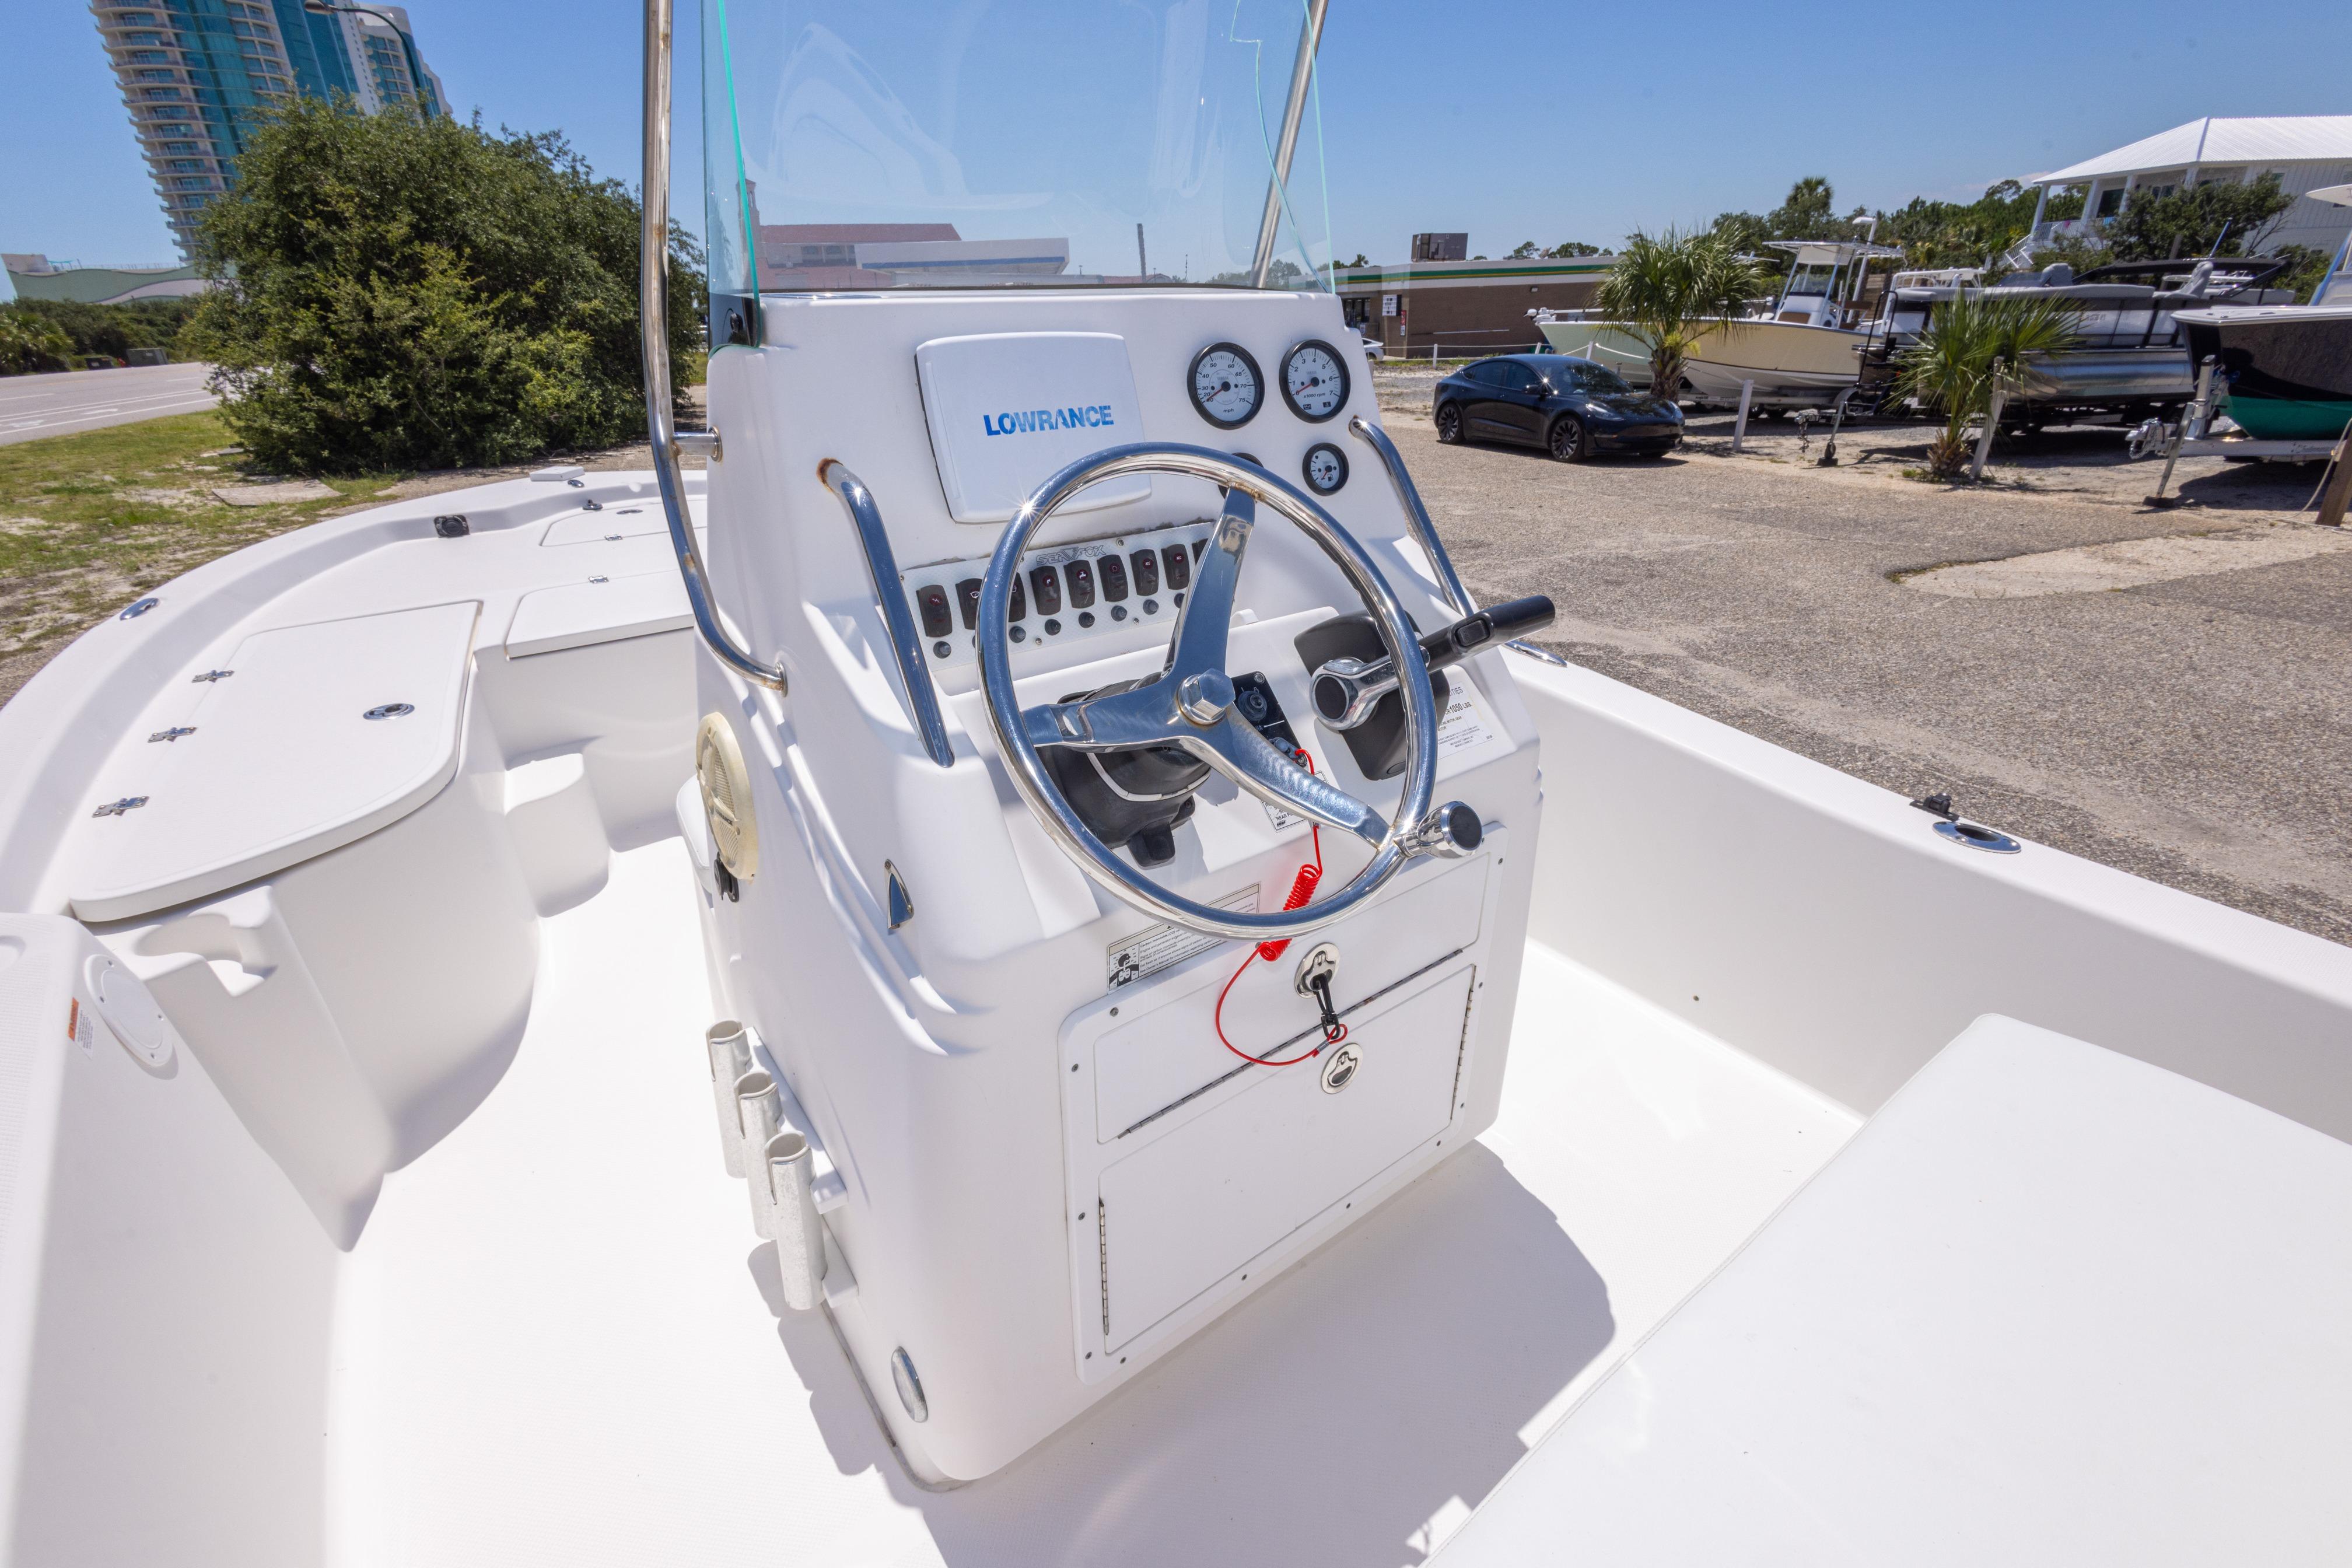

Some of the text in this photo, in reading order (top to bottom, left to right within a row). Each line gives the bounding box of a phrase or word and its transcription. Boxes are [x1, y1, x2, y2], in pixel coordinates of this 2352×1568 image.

[983, 405, 1114, 436] LOWRANCE
[1450, 703, 1463, 713] 1050
[1152, 935, 1168, 943] monoxide
